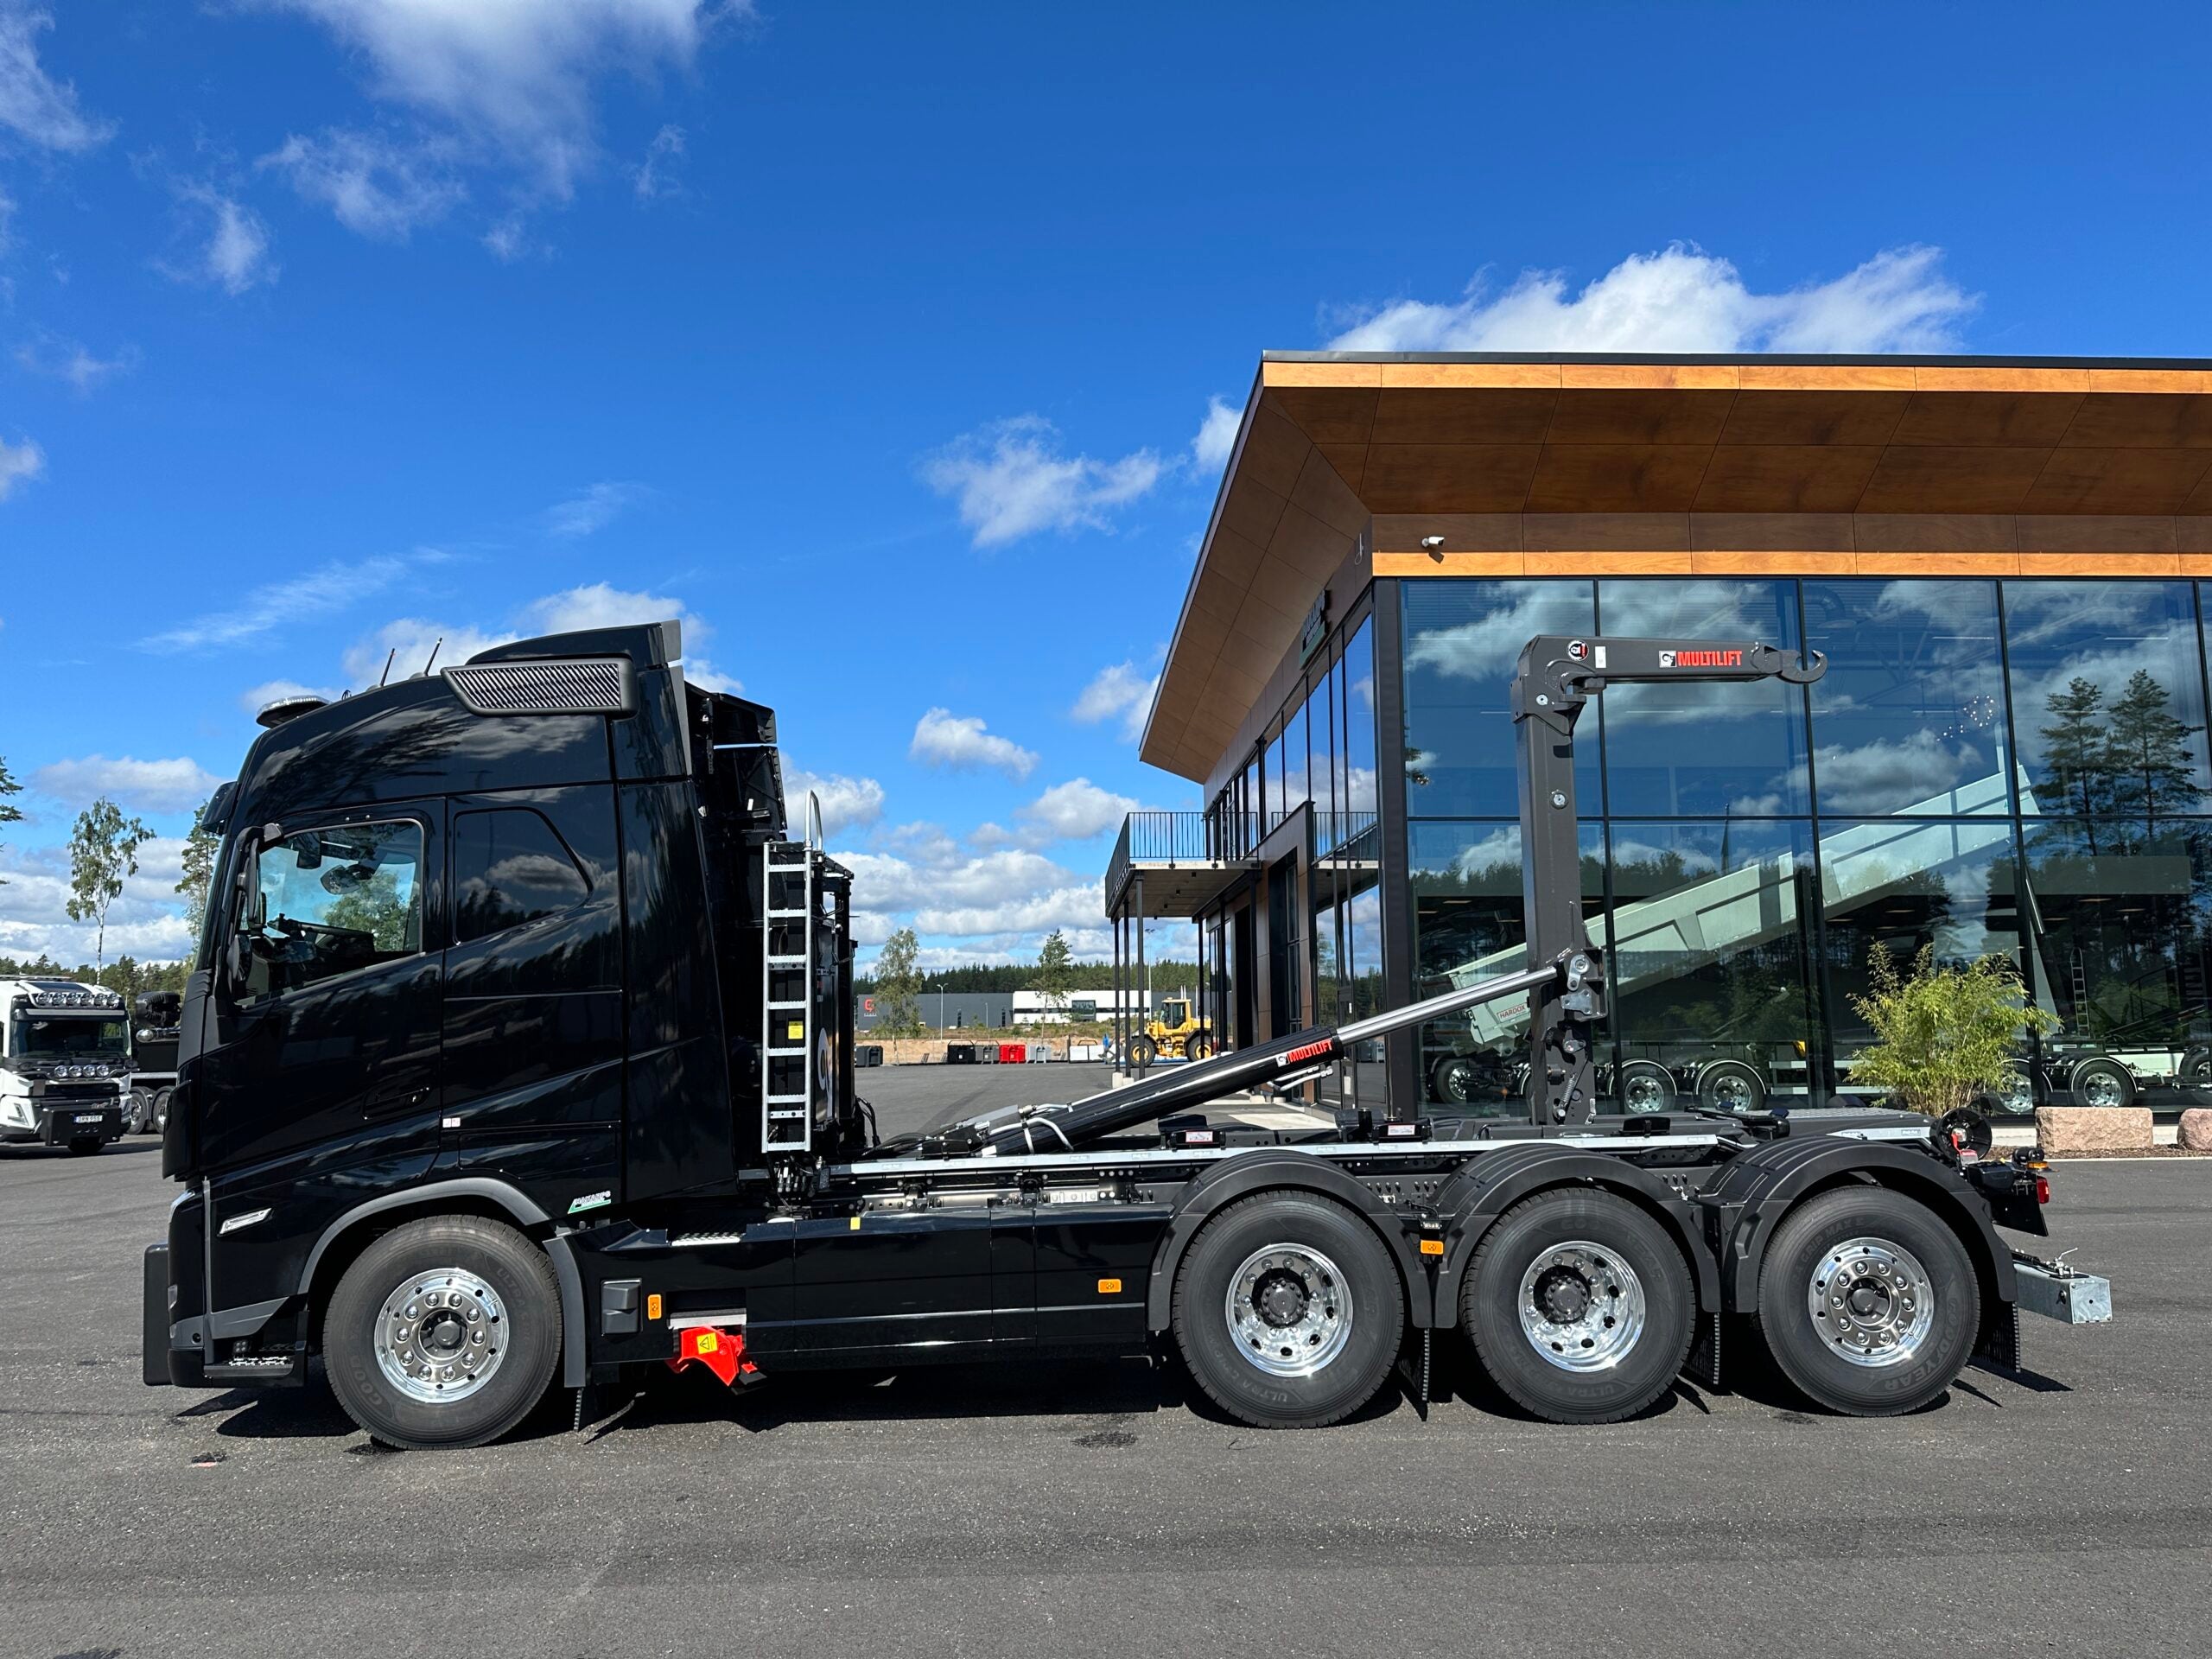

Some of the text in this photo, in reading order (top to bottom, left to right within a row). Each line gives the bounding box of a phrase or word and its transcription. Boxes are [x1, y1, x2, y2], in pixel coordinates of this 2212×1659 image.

[1677, 650, 1743, 667] MULTILIFT
[1288, 1039, 1332, 1063] MULTILIFT
[1884, 1297, 1959, 1392] GOODYEAR
